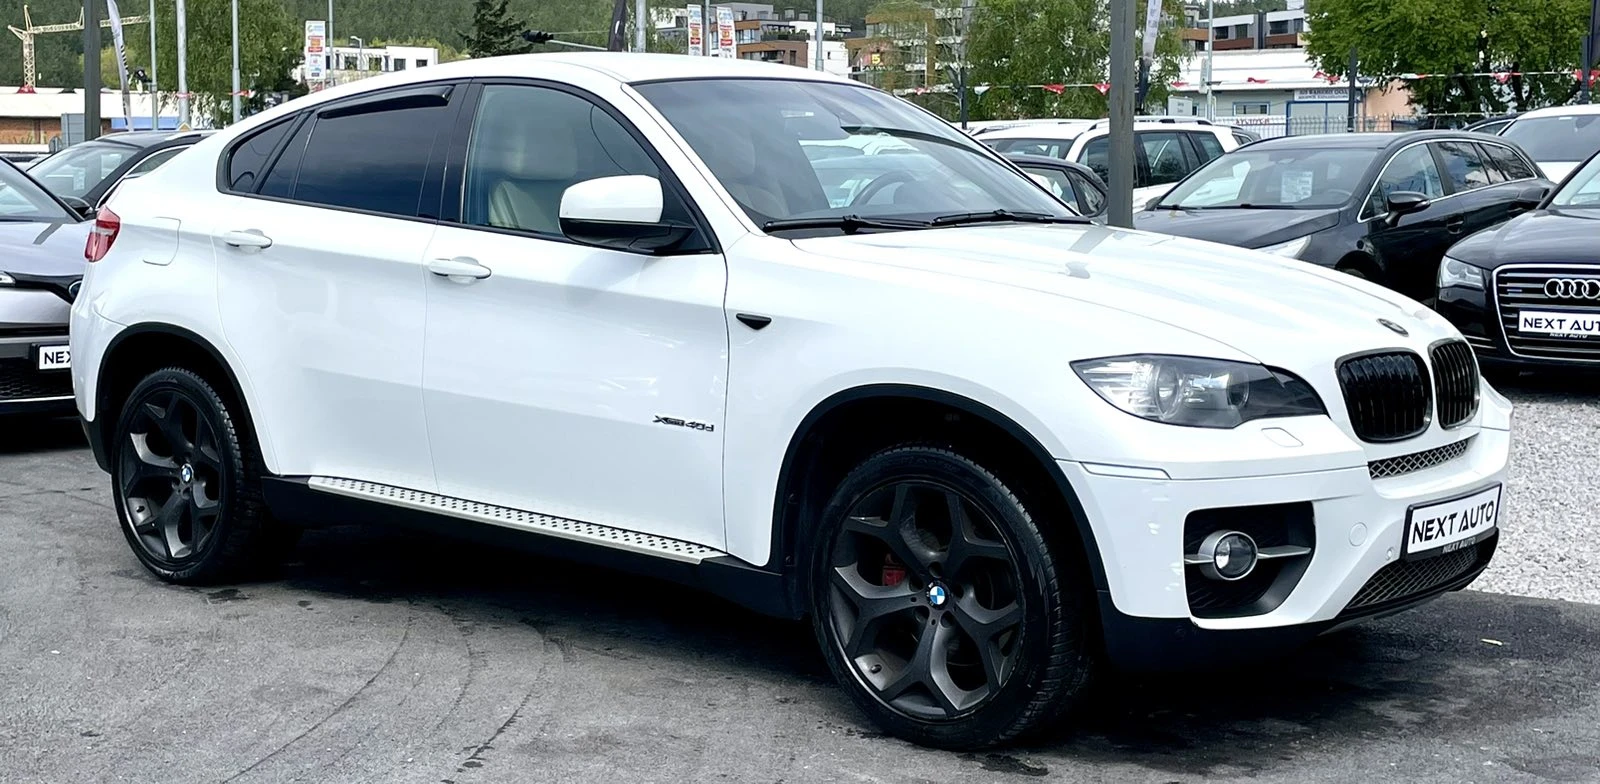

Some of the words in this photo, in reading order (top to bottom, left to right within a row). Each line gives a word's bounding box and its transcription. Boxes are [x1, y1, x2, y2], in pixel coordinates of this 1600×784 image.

[1524, 318, 1566, 329] NEXT
[1413, 512, 1457, 544] NEXT
[1458, 501, 1494, 532] AUTO
[1443, 542, 1460, 554] NEXT
[1460, 537, 1476, 548] AUTO
